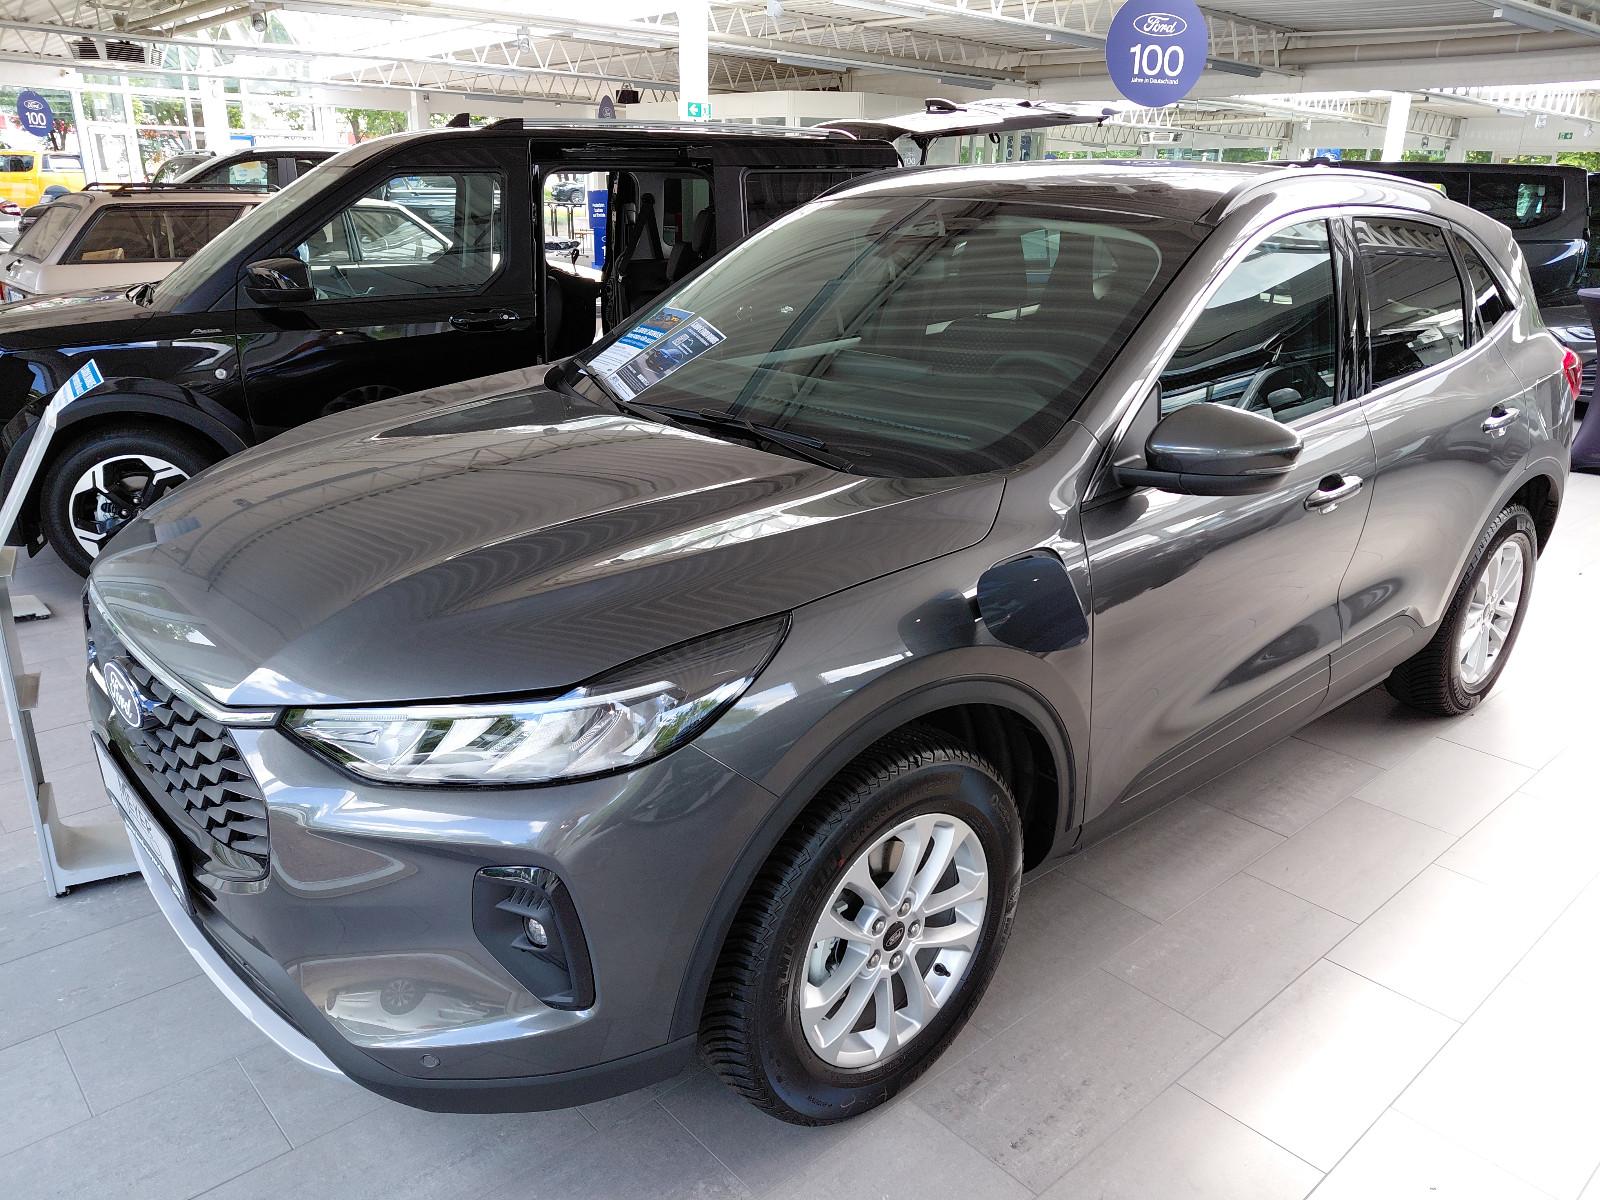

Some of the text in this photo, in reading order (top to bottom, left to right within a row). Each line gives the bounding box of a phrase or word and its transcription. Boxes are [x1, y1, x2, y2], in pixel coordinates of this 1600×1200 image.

[1143, 15, 1178, 33] Ford
[1129, 43, 1185, 77] 100
[1149, 77, 1179, 85] Deutschland
[25, 111, 47, 126] 100
